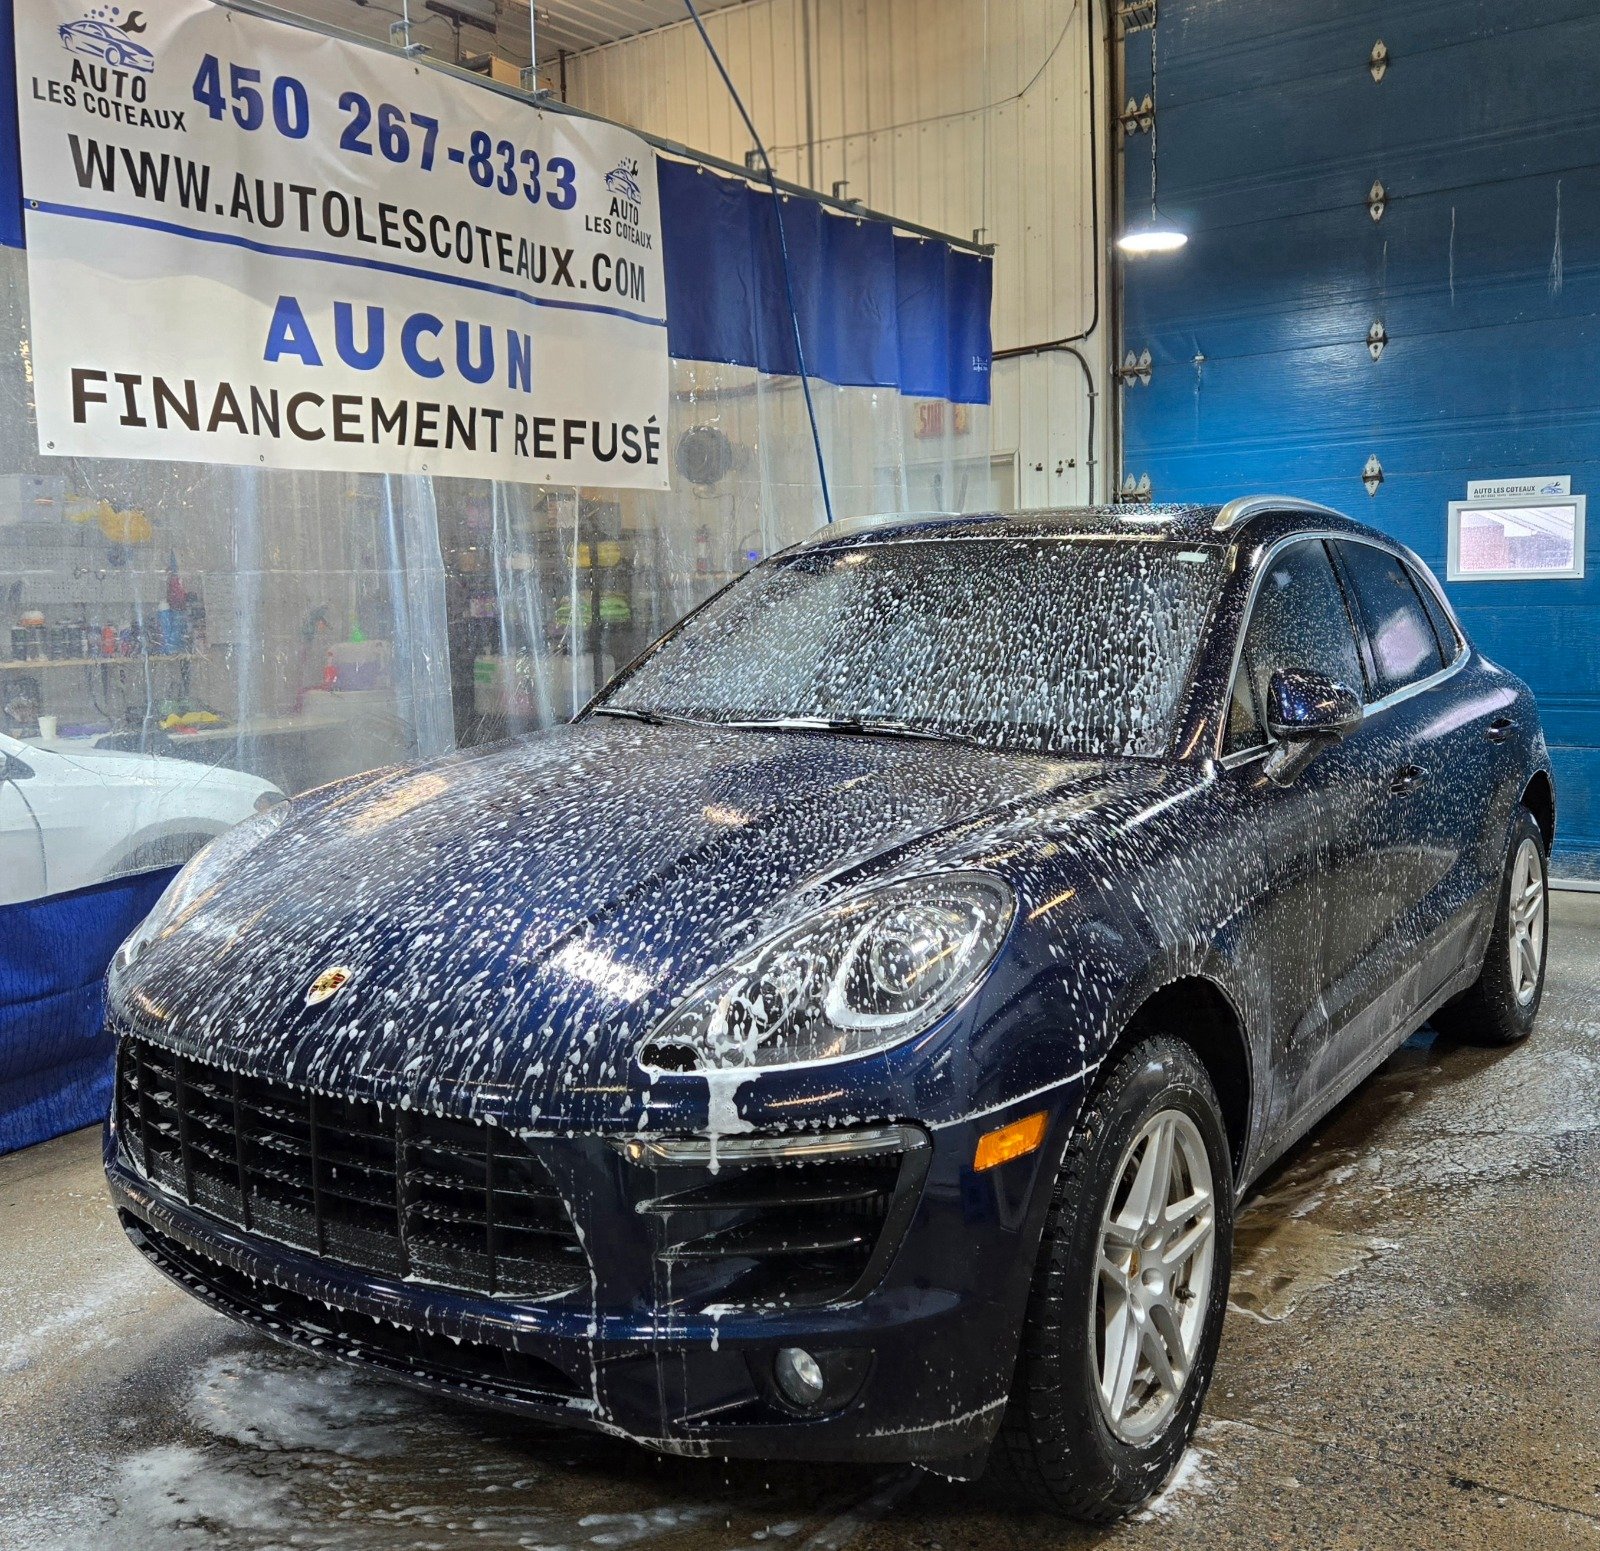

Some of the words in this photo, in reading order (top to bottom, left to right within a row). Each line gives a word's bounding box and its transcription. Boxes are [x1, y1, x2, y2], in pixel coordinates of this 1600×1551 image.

[32, 76, 77, 107] LES
[83, 91, 187, 132] COTEAUX
[71, 58, 147, 103] AUTO
[192, 53, 310, 139] 450
[338, 91, 577, 211] 267-8333
[67, 133, 646, 303] WWW.AUTOLESCOTEAUX.COM
[585, 214, 612, 235] LES
[616, 221, 652, 249] COTEAUX
[609, 197, 639, 226] AUTO
[263, 296, 532, 393] AUCUN
[71, 368, 504, 454] FINANCEMENT
[514, 410, 660, 465] REFUSÉ
